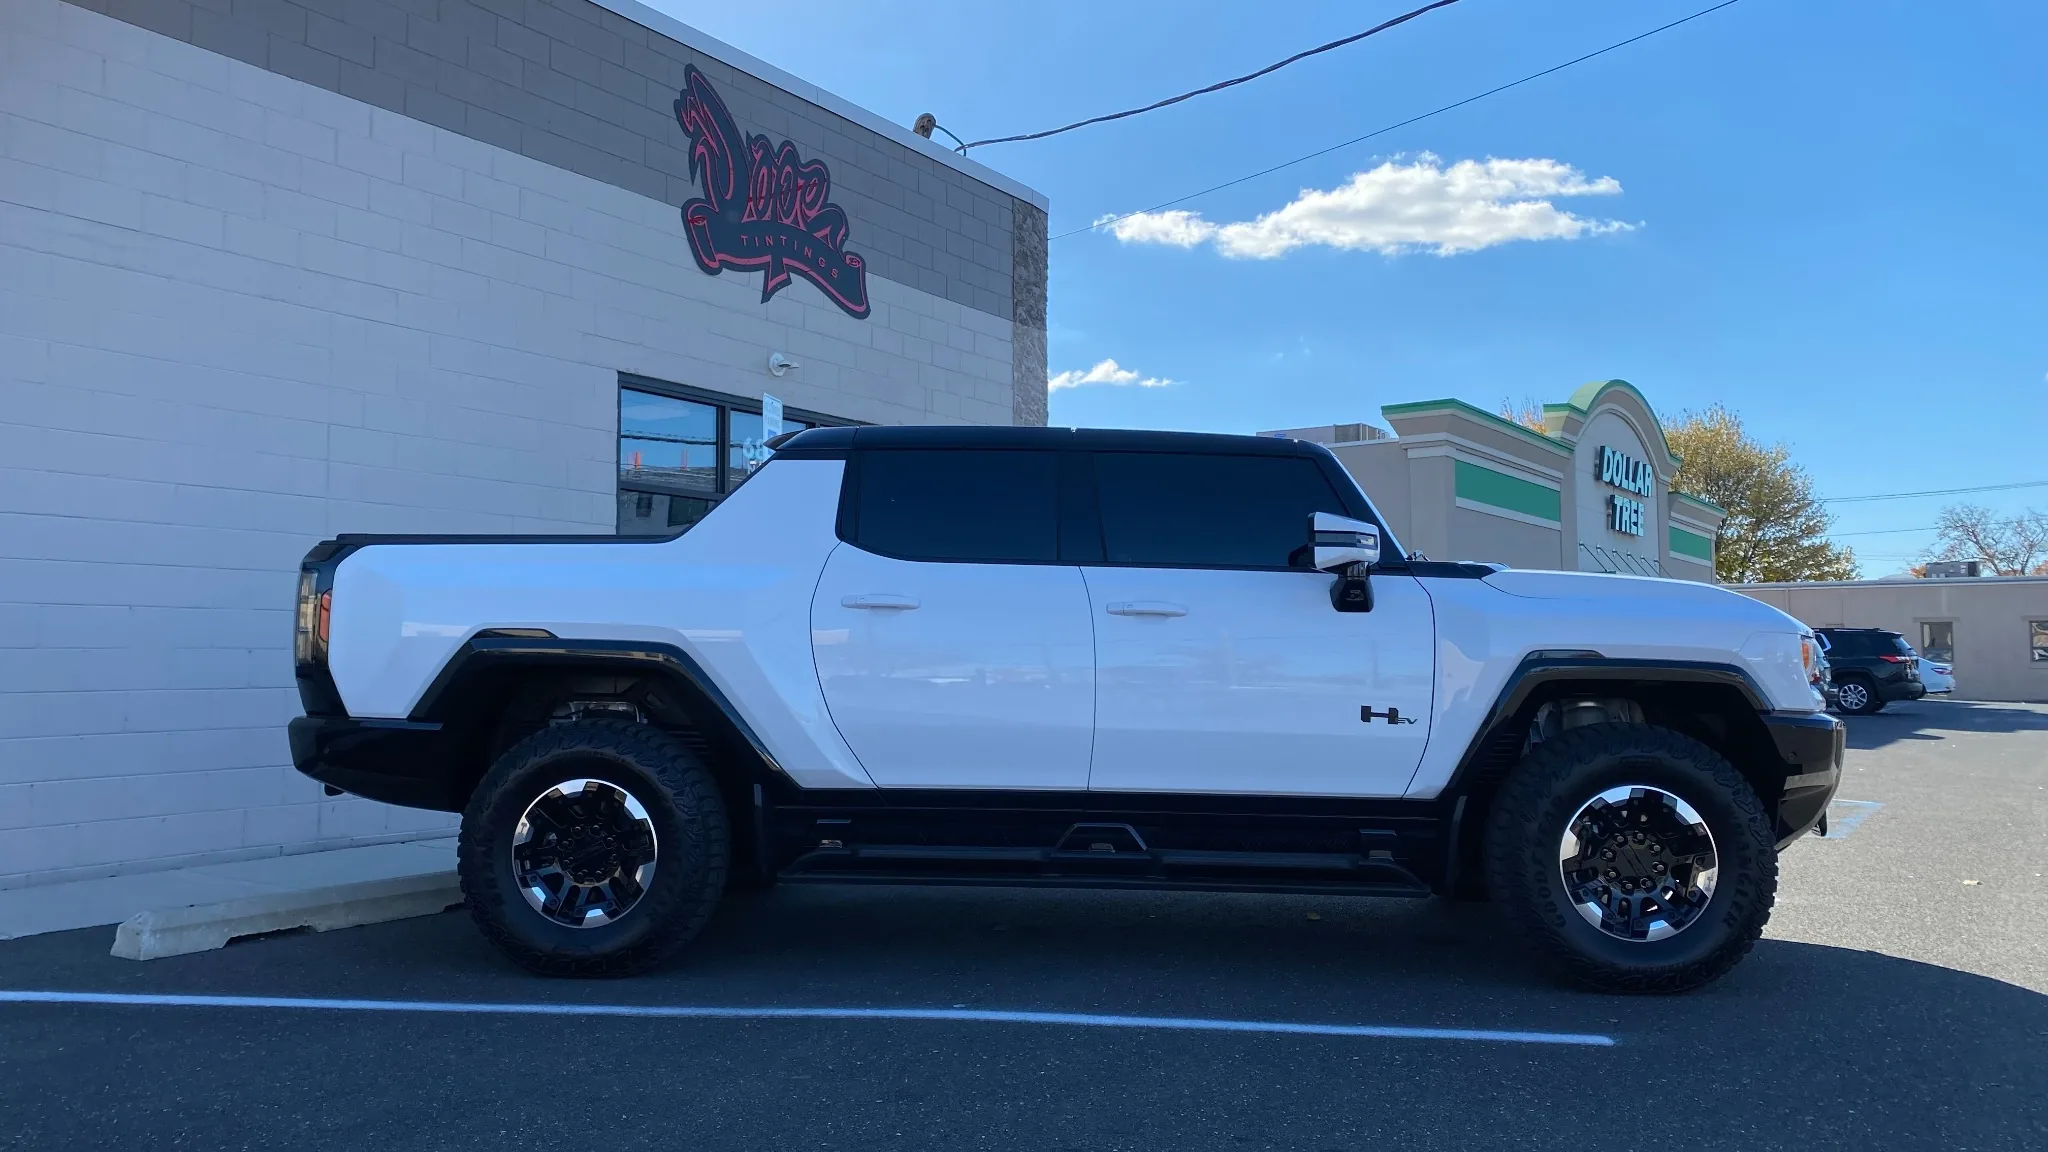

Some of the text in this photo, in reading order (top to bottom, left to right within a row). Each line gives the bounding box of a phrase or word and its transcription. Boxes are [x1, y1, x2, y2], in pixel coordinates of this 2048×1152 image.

[740, 235, 839, 279] TINTINGS
[1601, 446, 1653, 497] DOLLAR
[1611, 495, 1645, 537] TREE
